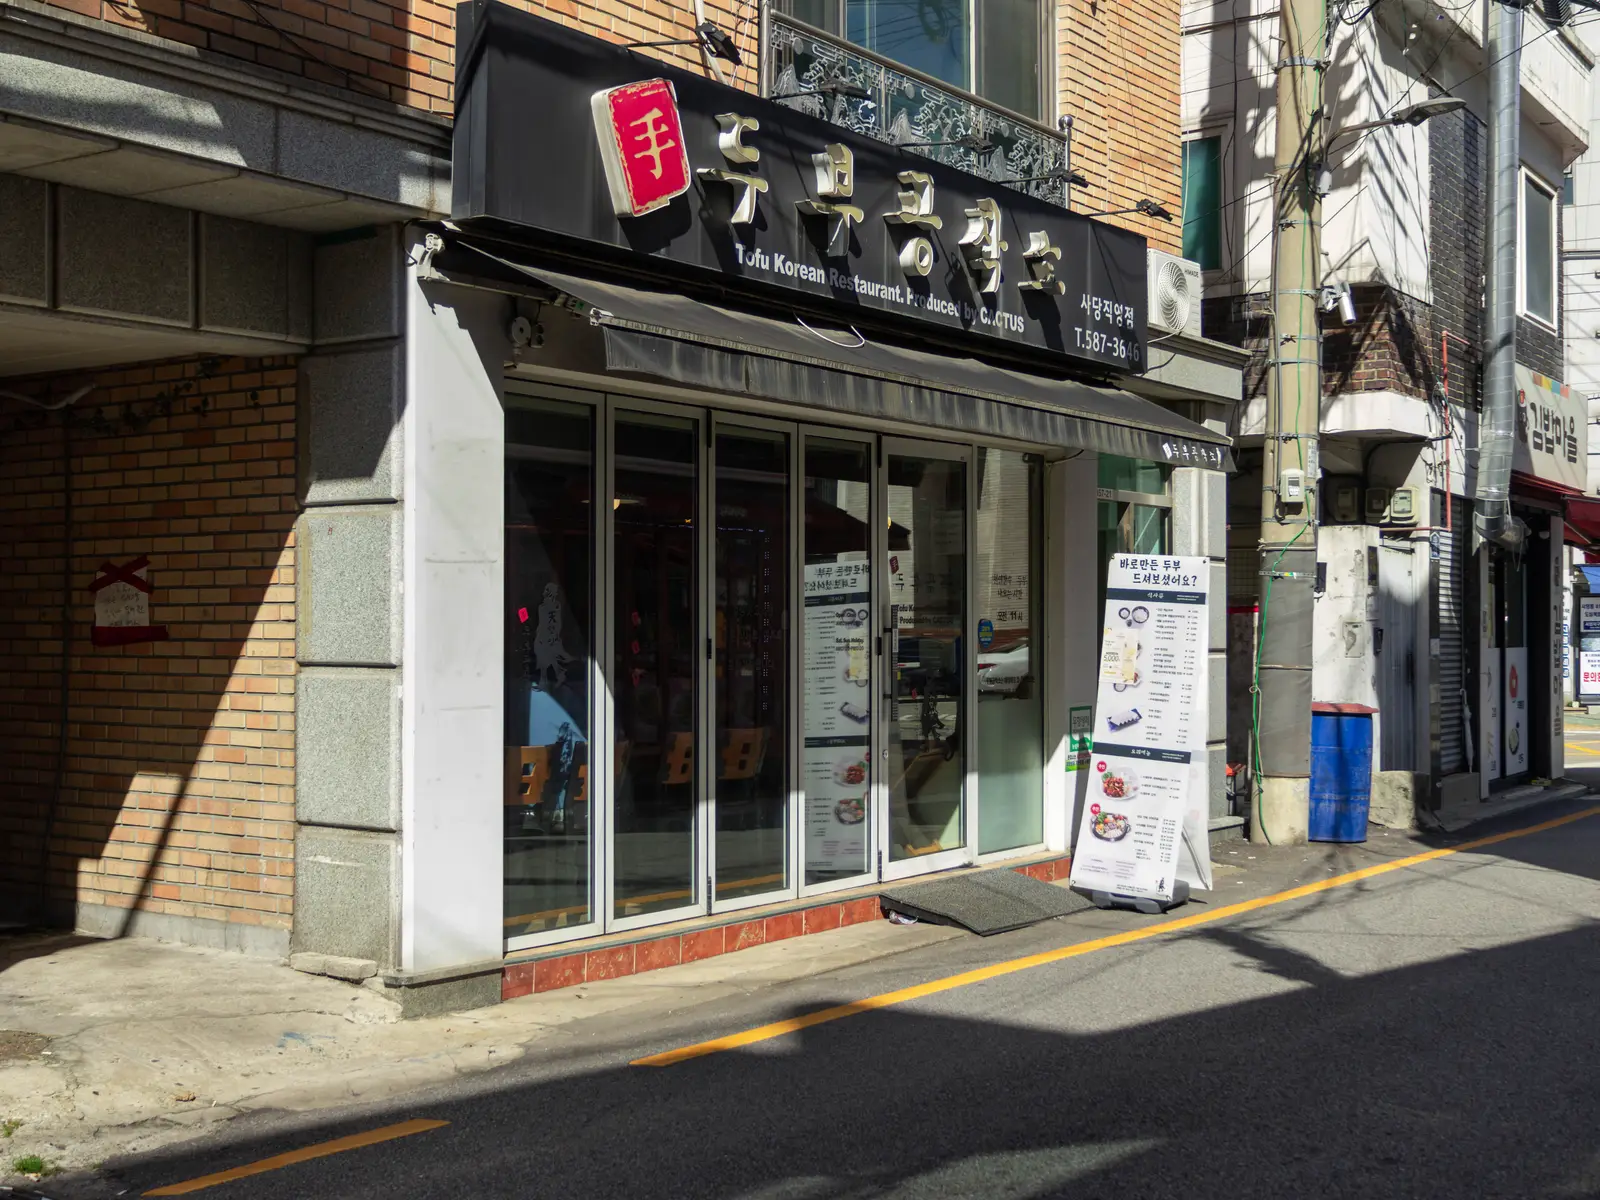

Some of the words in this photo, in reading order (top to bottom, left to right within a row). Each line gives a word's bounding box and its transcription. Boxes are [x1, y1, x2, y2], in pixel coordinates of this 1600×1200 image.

[630, 107, 676, 180] 手
[735, 243, 770, 270] Tofu
[774, 252, 825, 284] Korean
[829, 267, 904, 303] Restaurant.
[906, 287, 960, 317] Produced
[964, 302, 977, 325] by
[980, 306, 1025, 333] CACTUS
[1080, 293, 1135, 329] 사당직영점
[1074, 327, 1140, 362] T.587-3646
[1529, 402, 1577, 463] 김밥마을
[1120, 558, 1159, 571] 바로만든
[1162, 560, 1181, 572] 두부
[1133, 573, 1197, 587] 드셔보셨어요?
